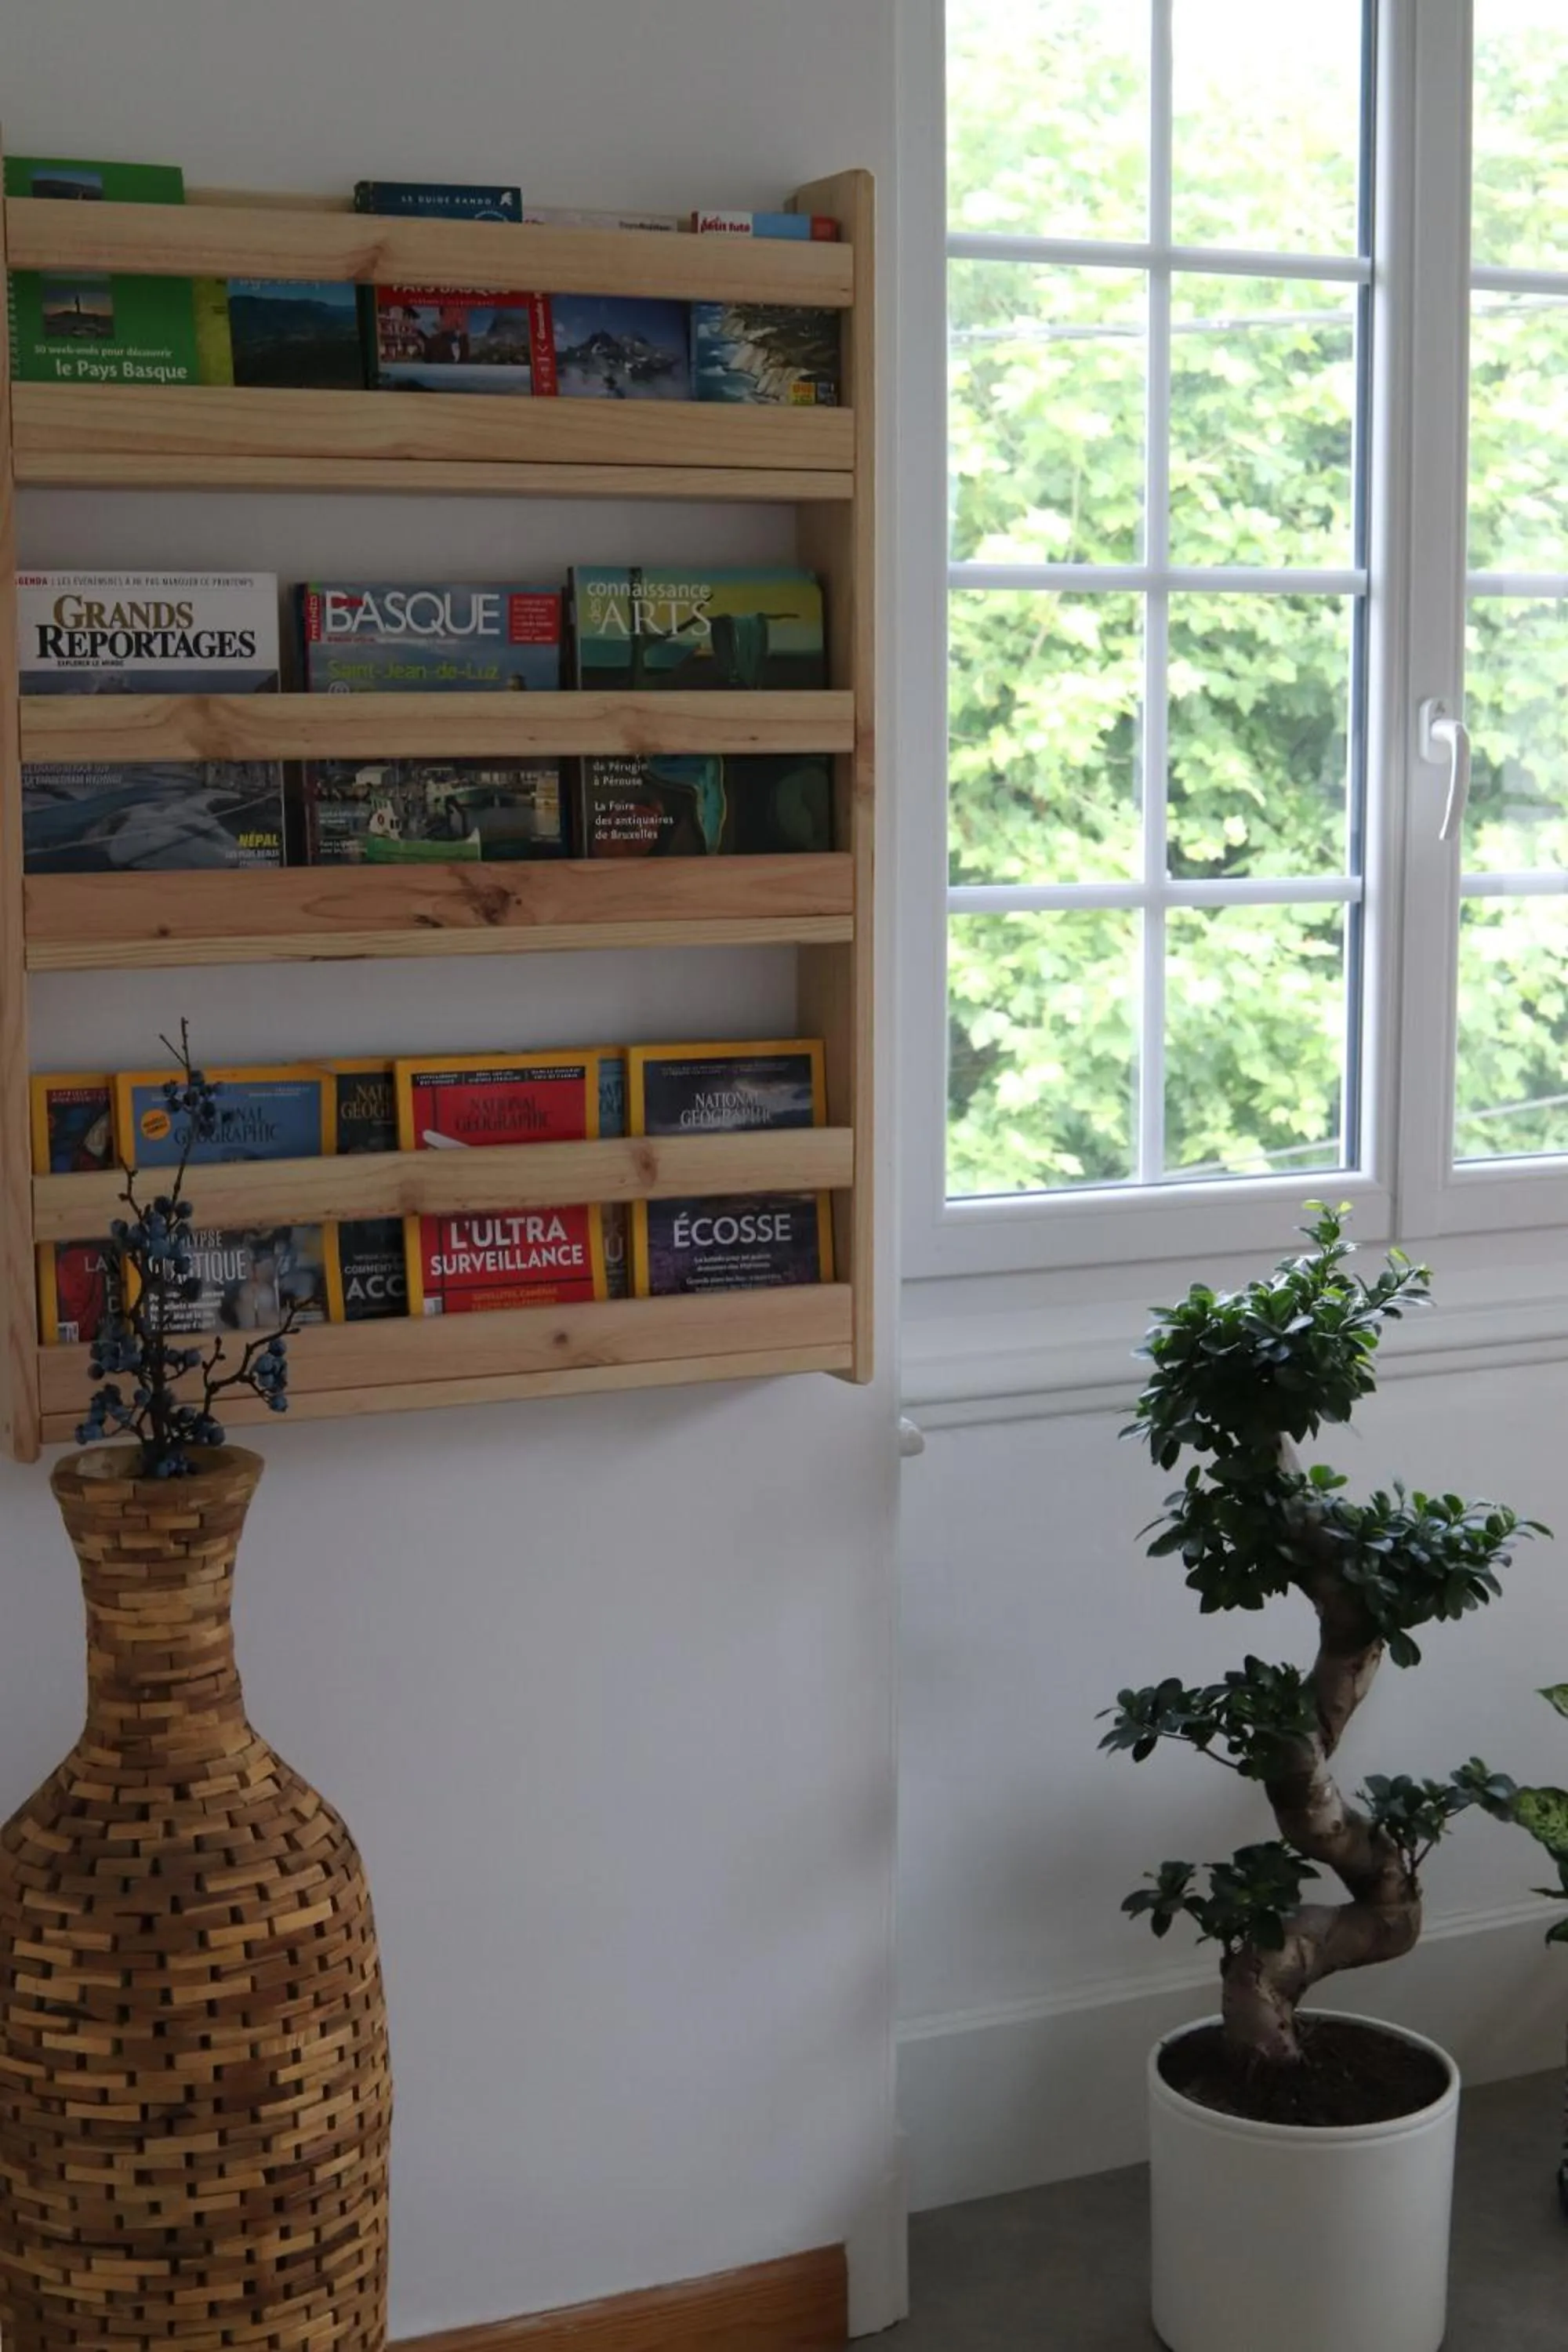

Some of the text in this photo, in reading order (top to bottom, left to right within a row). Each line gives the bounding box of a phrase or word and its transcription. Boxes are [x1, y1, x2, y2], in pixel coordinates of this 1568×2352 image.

[56, 358, 188, 383] le Pays Basque
[16, 576, 48, 586] GENDA
[586, 577, 712, 599] connaissance
[53, 594, 194, 630] GRANDS
[325, 590, 501, 637] BASQUE
[597, 598, 713, 637] ARTS
[34, 624, 256, 659] REPORTAGES
[594, 800, 636, 811] La Foire
[595, 815, 674, 828] des antiquaires
[238, 830, 280, 848] NÉPAL
[595, 829, 659, 840] de Bruxelles
[695, 1091, 759, 1110] NATIONAL
[680, 1105, 771, 1128] GEOGRAPHIC
[173, 1120, 280, 1145] GGRAPHIC
[450, 1215, 568, 1250] L'ULTRA
[673, 1211, 793, 1249] ÉCOSSE
[430, 1243, 584, 1276] SURVEILLANCE
